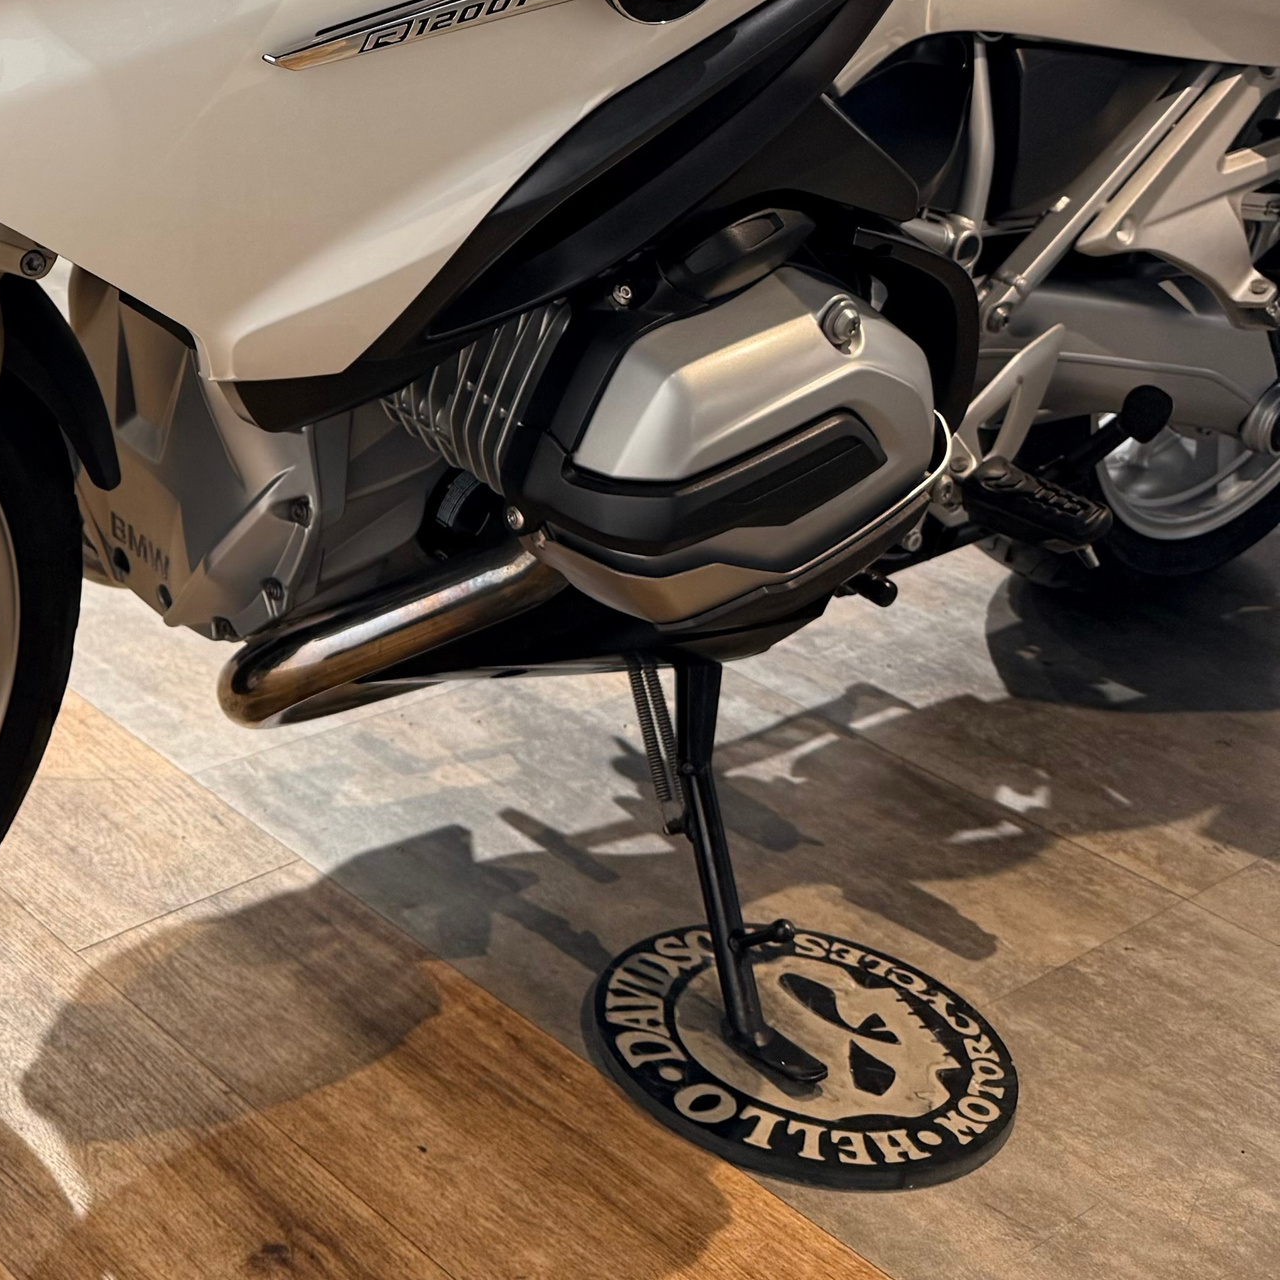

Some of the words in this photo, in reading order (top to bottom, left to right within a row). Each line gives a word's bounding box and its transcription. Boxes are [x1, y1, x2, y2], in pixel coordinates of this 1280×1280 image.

[110, 510, 170, 580] BMW
[792, 933, 1005, 1146] MOTORCYCLES
[673, 1082, 932, 1166] HELLO
